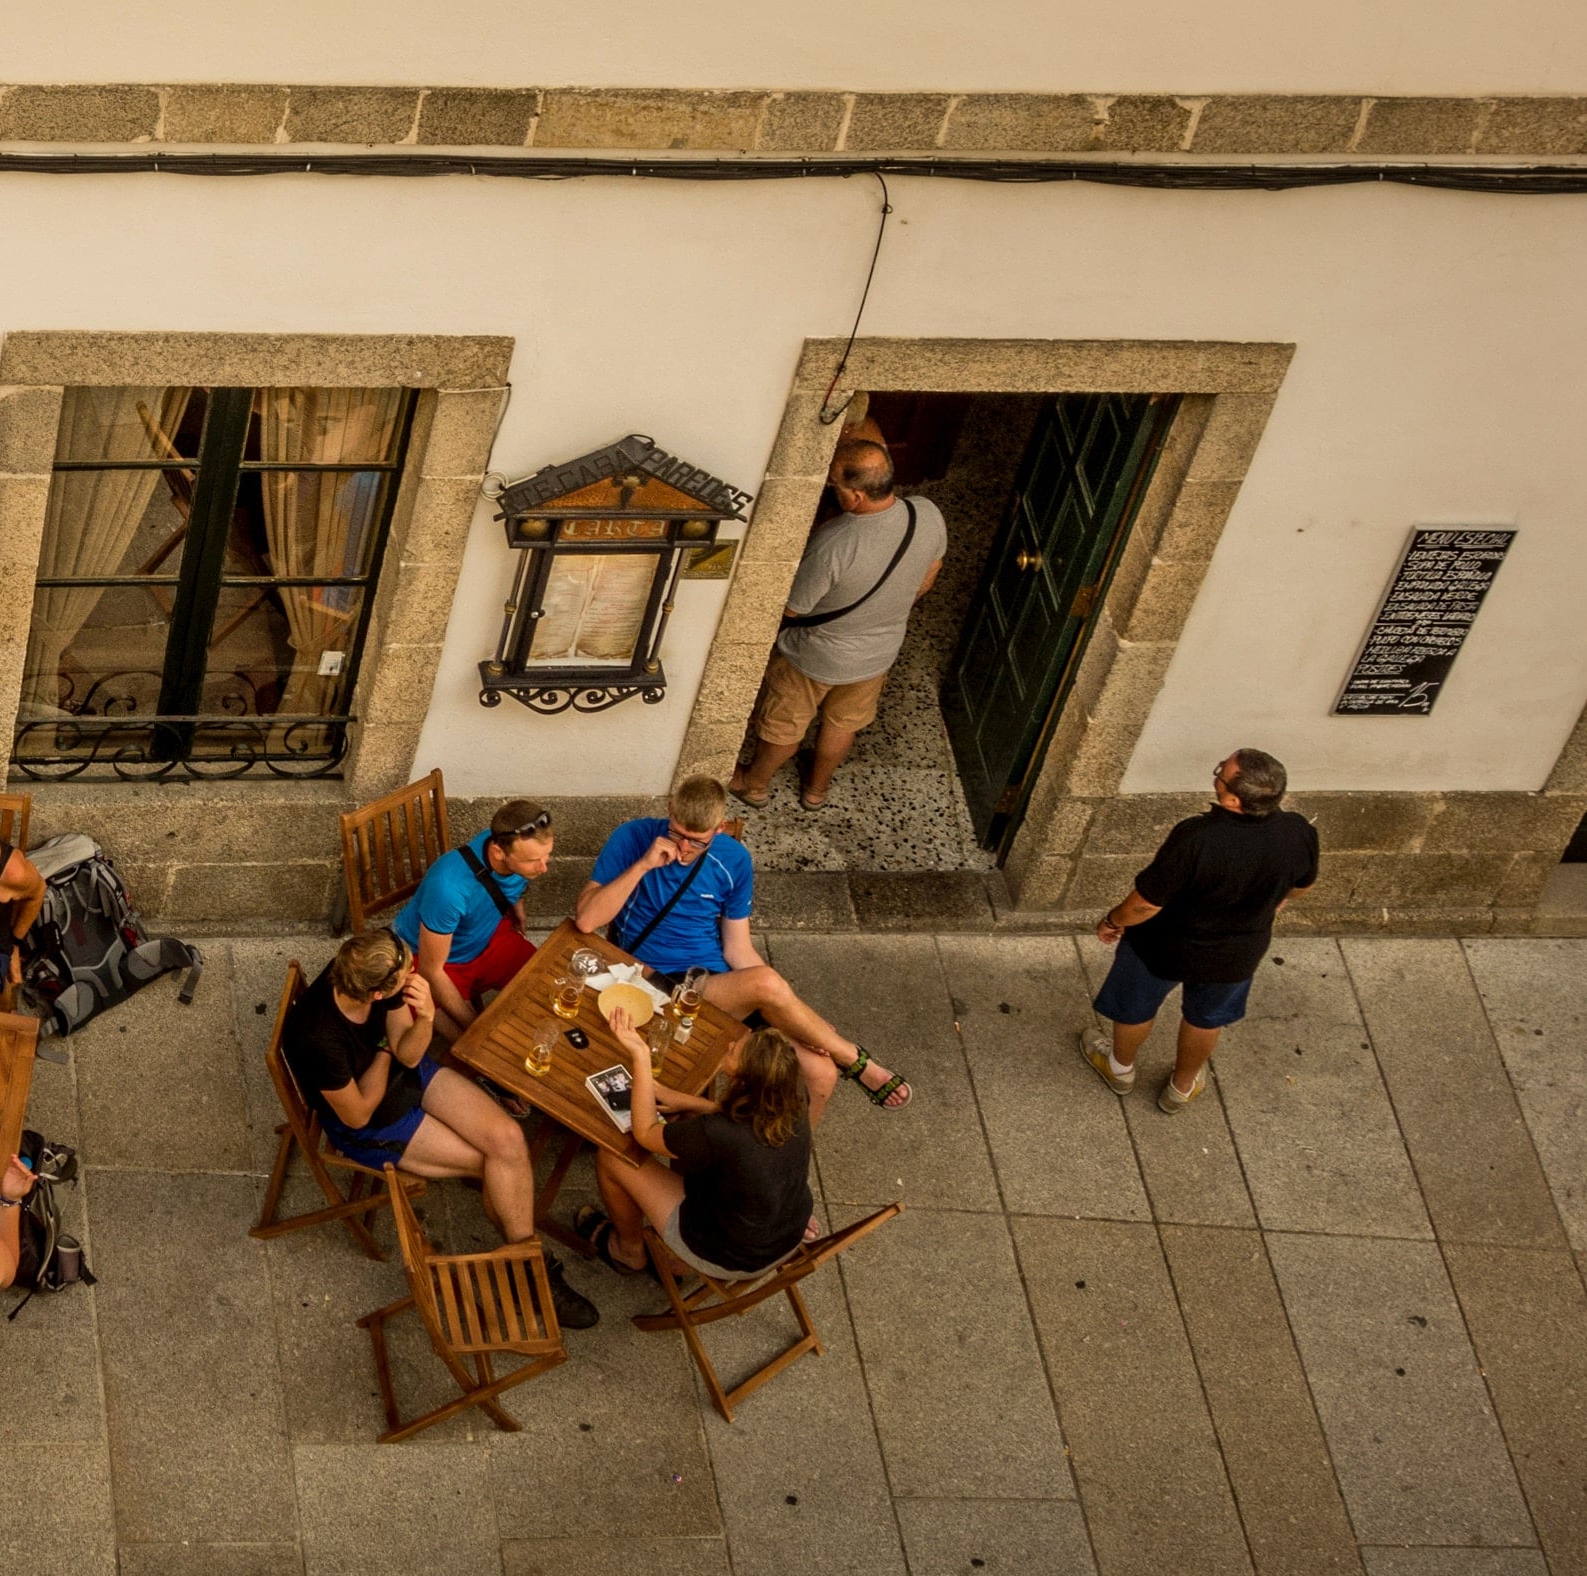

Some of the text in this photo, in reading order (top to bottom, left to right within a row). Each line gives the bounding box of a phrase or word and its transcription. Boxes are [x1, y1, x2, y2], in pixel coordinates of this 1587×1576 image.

[641, 449, 754, 513] PAREDES
[563, 519, 666, 536] CARTA
[1454, 532, 1512, 544] ESPECIAL
[1404, 561, 1482, 570] SOPA DE POLLO
[1389, 592, 1478, 601] ENSALADA VERDE
[1384, 602, 1436, 611] ENSALADA
[1370, 635, 1399, 644] PULPO
